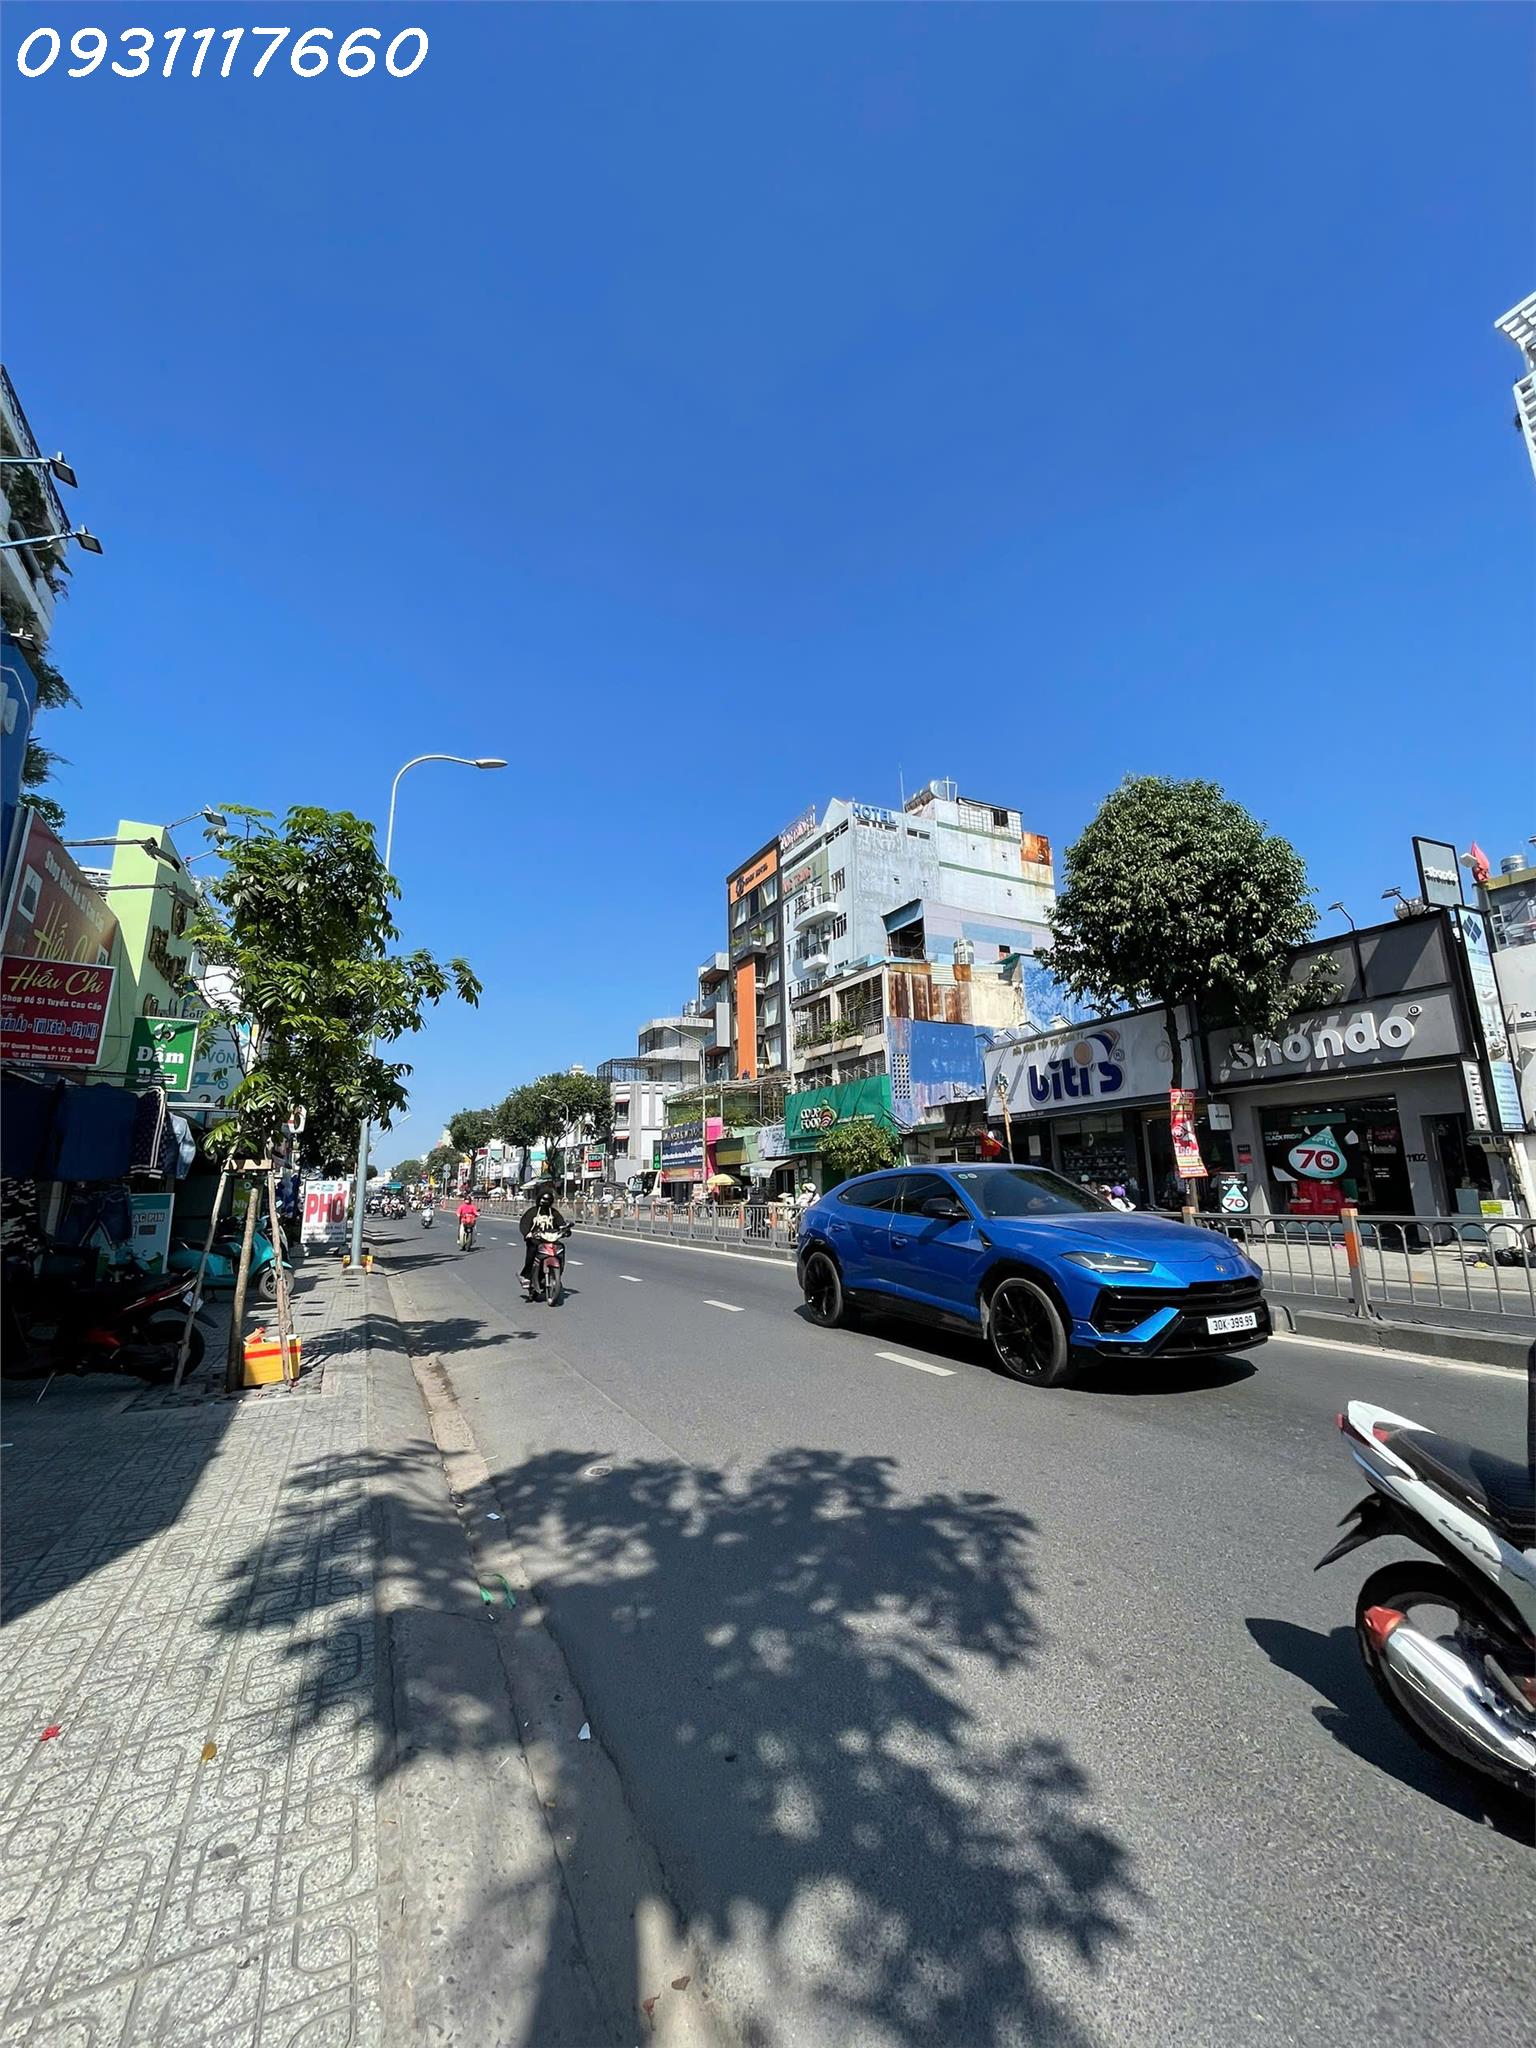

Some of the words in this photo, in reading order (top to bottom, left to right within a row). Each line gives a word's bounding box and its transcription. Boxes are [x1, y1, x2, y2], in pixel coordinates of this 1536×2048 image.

[852, 803, 896, 824] HOTEL
[2, 994, 22, 1004] Shop
[136, 1044, 185, 1064] Đầm
[1407, 1153, 1428, 1162] 1102
[305, 1183, 347, 1223] PHỞ
